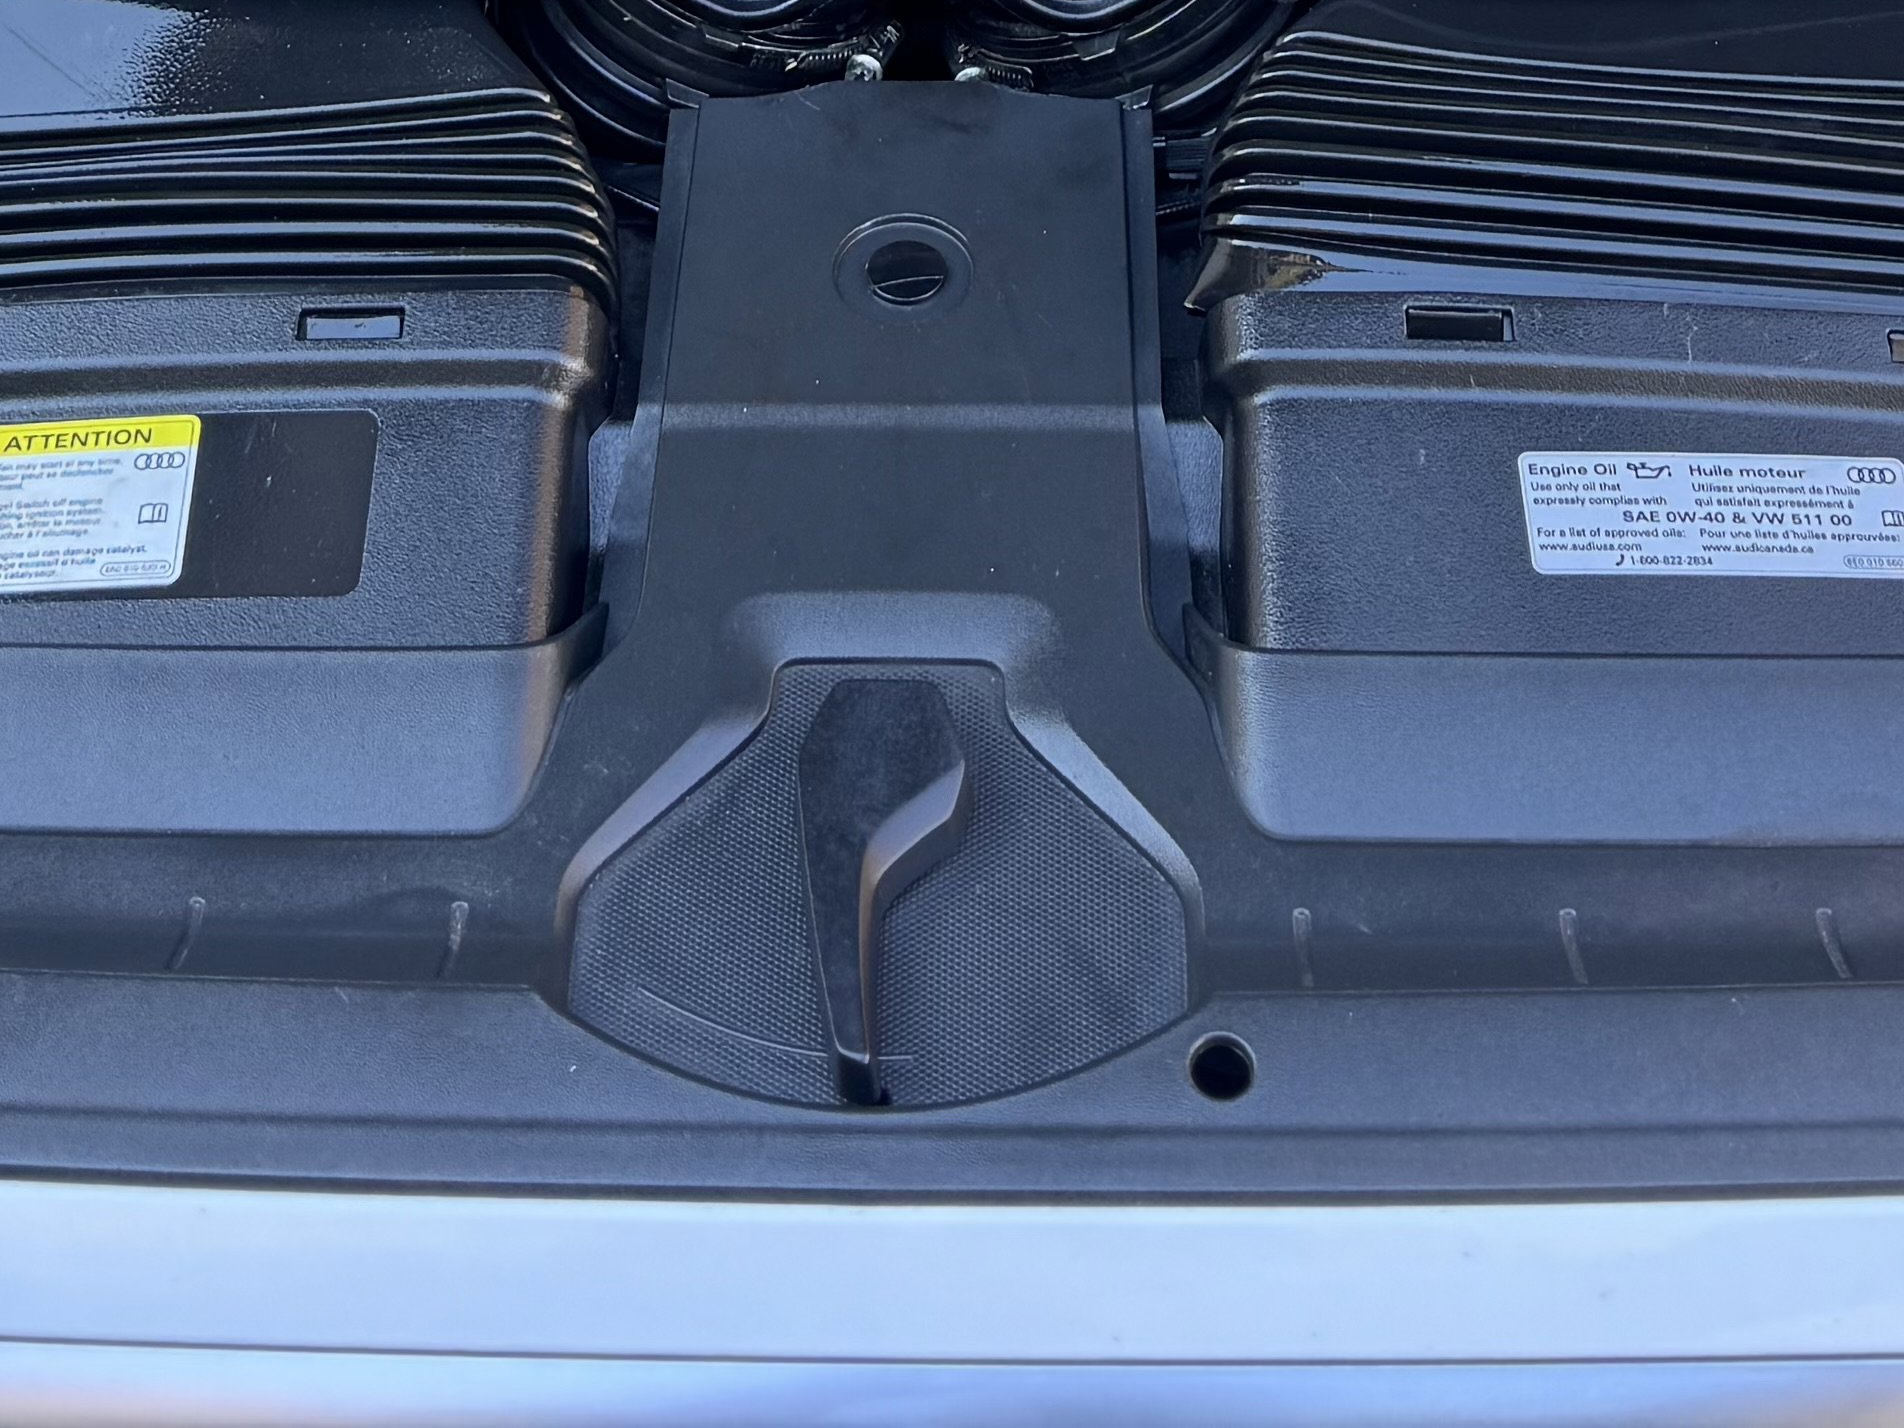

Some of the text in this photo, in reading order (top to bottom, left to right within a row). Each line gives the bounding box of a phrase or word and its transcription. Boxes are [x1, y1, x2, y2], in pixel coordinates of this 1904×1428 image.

[4, 428, 153, 452] ATTENTION
[1528, 463, 1806, 479] Engine Oil Huile moteur
[1530, 481, 1621, 492] Use only oil that
[1692, 482, 1734, 493] Utilisez
[1737, 485, 1806, 496] uniquement
[1808, 485, 1823, 495] de
[1533, 495, 1667, 508] expressly complies with
[1694, 498, 1714, 508] qui
[1716, 498, 1761, 508] satisfait
[1622, 510, 1853, 527] SAE 0W-40 & VW 511 00
[1537, 527, 1556, 538] For
[1569, 527, 1587, 538] list
[1590, 527, 1601, 537] of
[1604, 528, 1659, 540] approved
[1699, 529, 1726, 539] Pour
[1731, 530, 1752, 539] une
[1755, 529, 1779, 539] liste
[1539, 542, 1642, 552] www.audiusa.com
[1702, 544, 1815, 555] www.audicanada.ca
